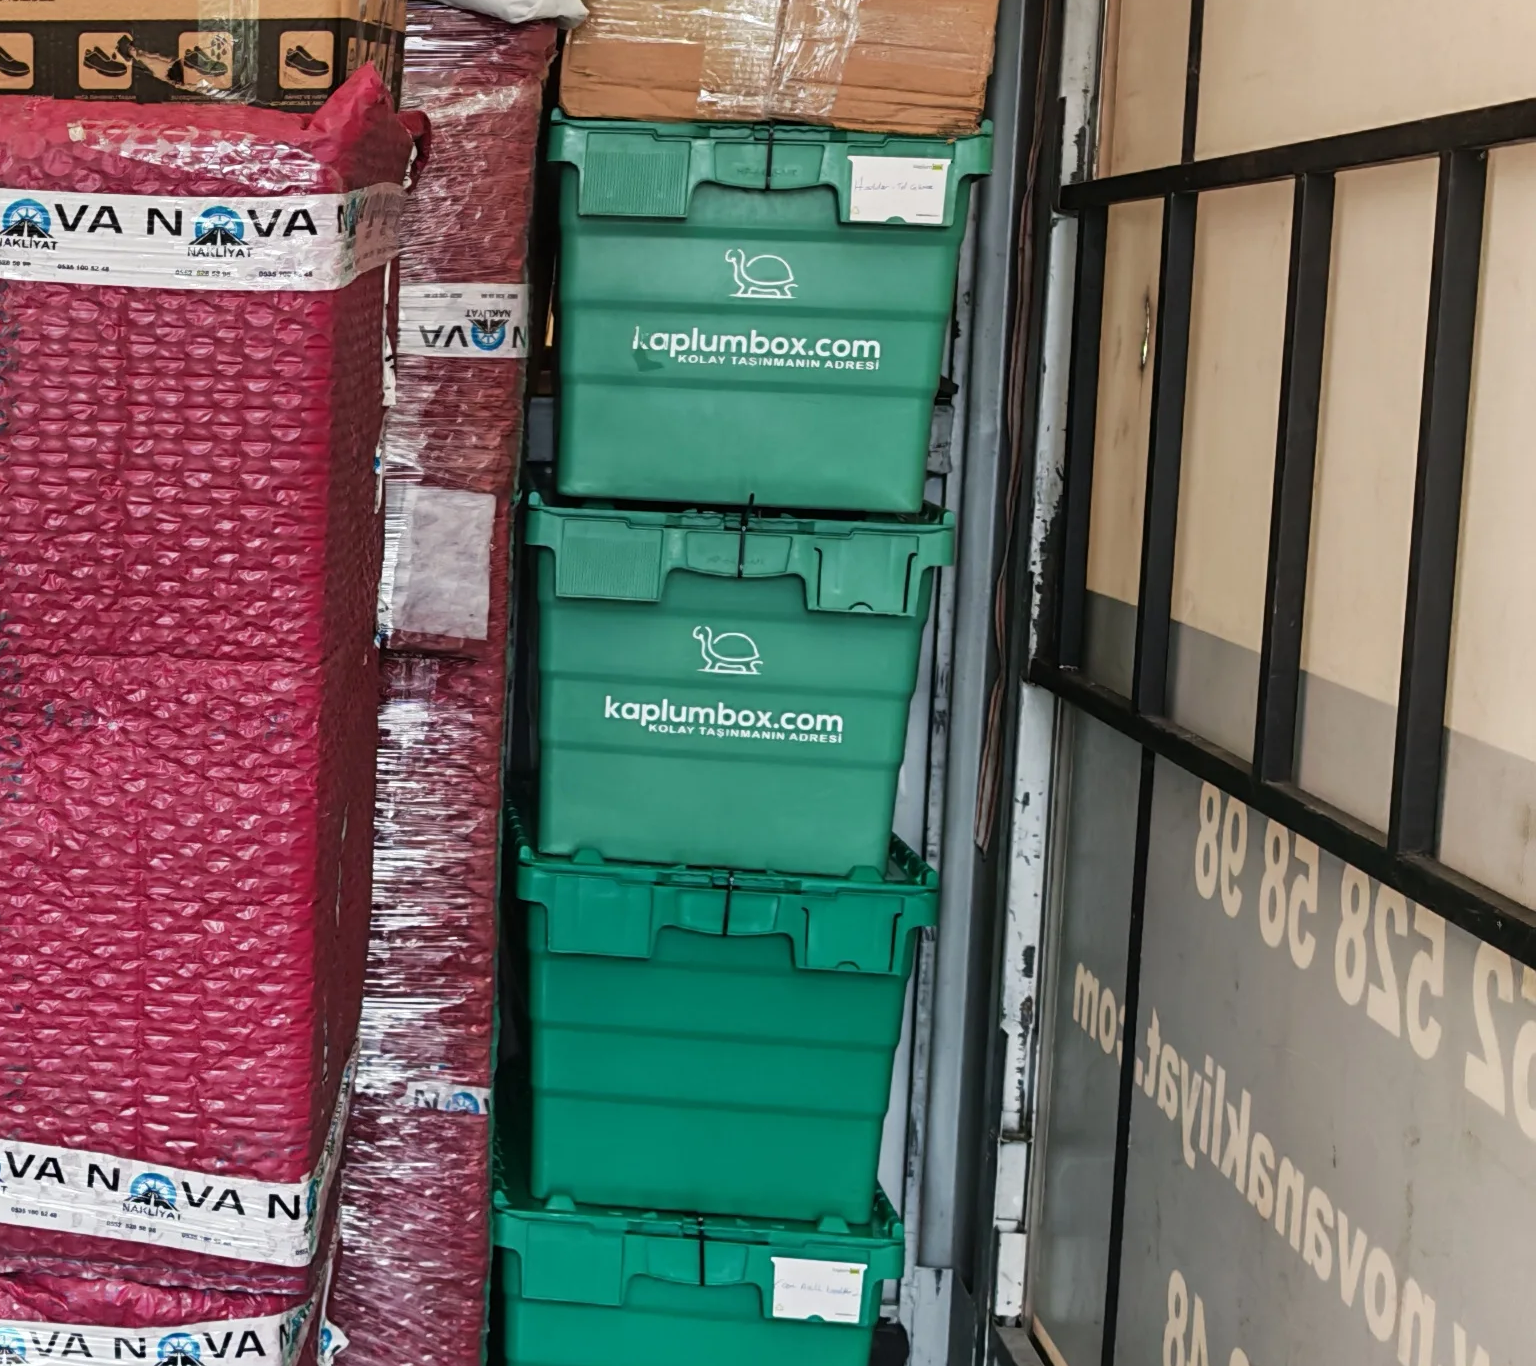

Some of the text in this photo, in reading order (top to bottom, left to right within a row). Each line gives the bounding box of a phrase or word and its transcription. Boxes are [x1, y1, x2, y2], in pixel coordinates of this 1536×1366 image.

[678, 354, 880, 370] KOLAY TAŞINMANIN ADRESİ
[605, 695, 843, 733] kaplumbox.com
[649, 723, 842, 744] KOLAY TAŞINMANIN ADRESİ
